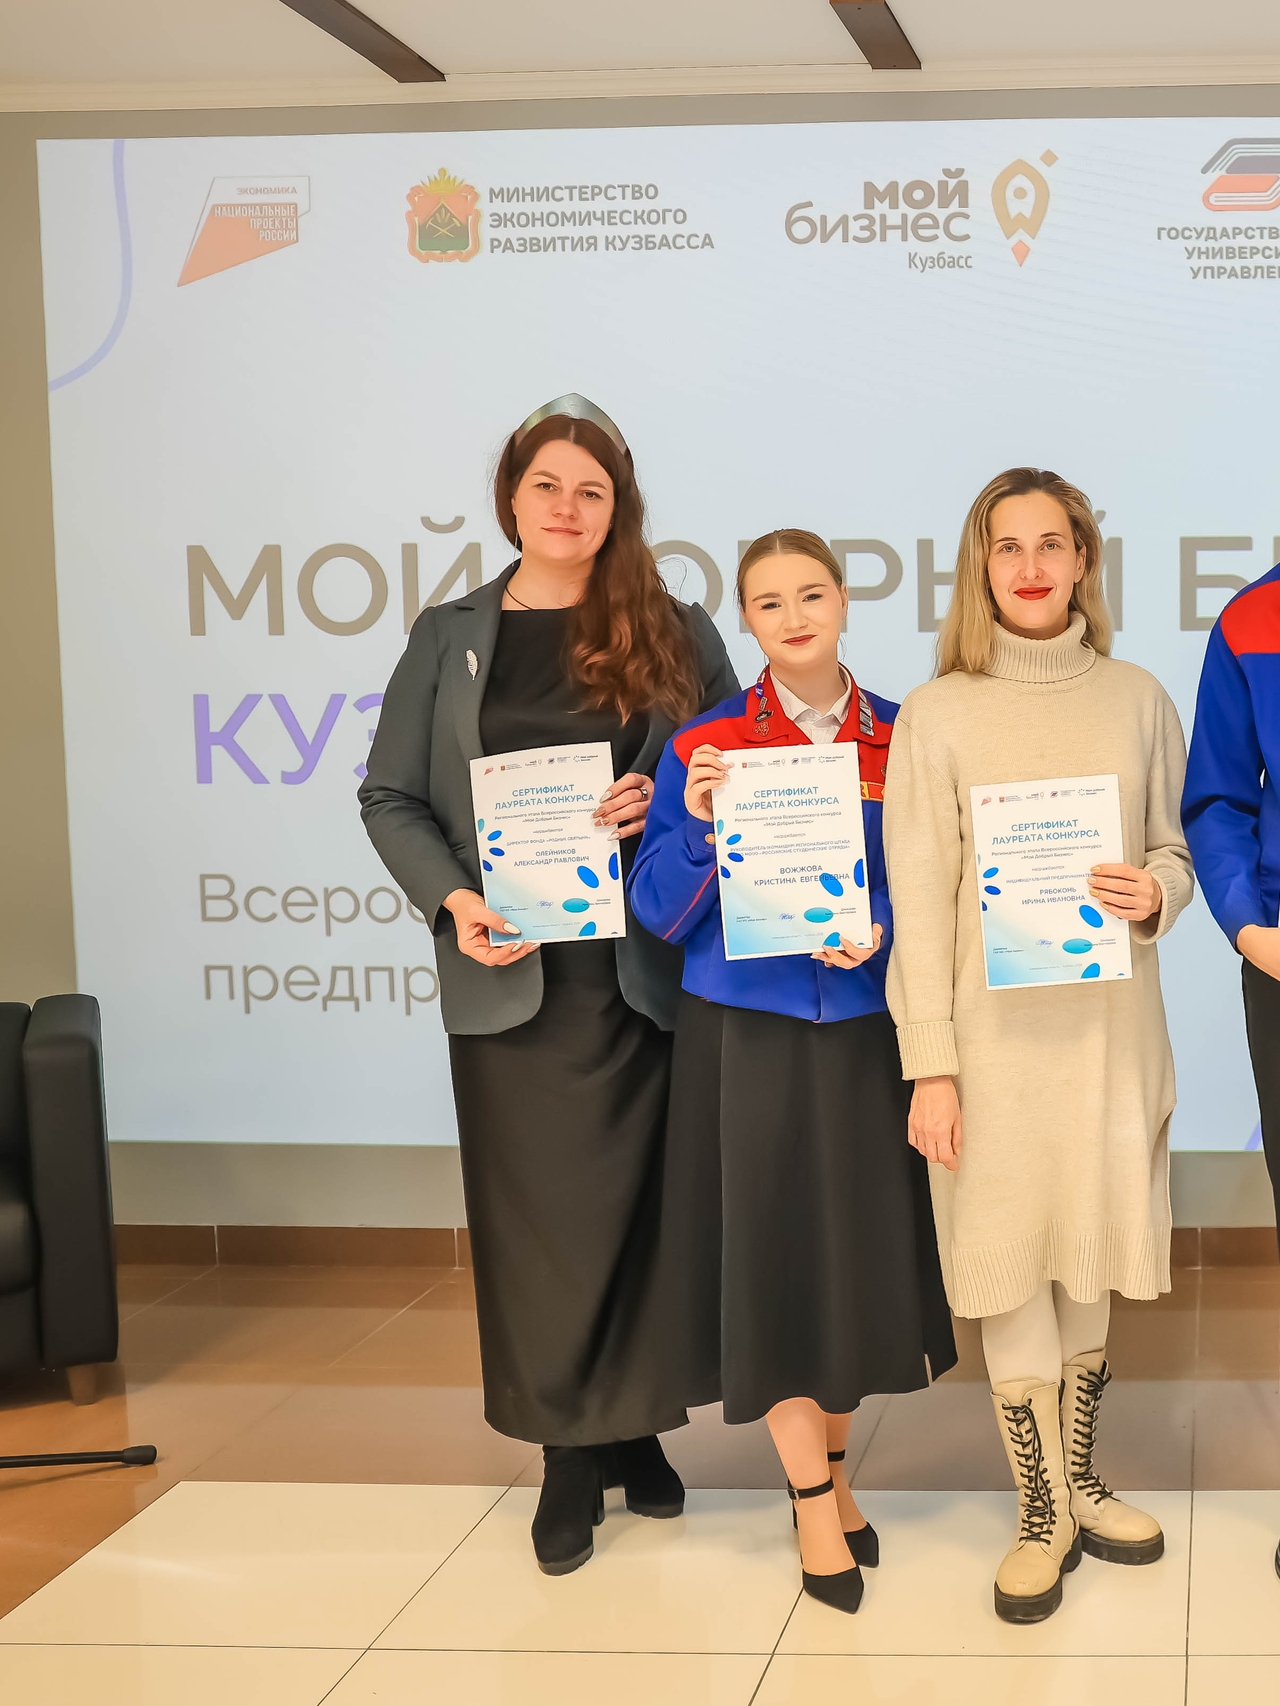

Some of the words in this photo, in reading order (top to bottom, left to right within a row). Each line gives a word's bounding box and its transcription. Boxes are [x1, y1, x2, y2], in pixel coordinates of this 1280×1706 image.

[237, 187, 298, 195] ЭКОНОМИКА
[488, 183, 659, 203] МИНИСТЕРСТВО
[863, 168, 969, 210] мой
[214, 205, 296, 218] НАЦИОНАЛЬНЫЕ
[489, 208, 688, 228] ЭКОНОМИЧЕСКОГО
[250, 218, 297, 229] ПРОЕКТЫ
[784, 201, 971, 245] бизнес
[259, 229, 297, 241] РОССИИ
[489, 236, 598, 254] РАЗВИТИЯ
[605, 233, 715, 252] КУЗБАССА
[908, 251, 973, 274] Кузбасс
[512, 784, 575, 797] СЕРТИФИКАТ
[754, 786, 819, 798] СЕРТИФИКАТ
[494, 798, 543, 810] ЛАУРЕАТА
[545, 793, 594, 804] КОНКУРСА
[735, 800, 785, 811] ЛАУРЕАТА
[787, 796, 839, 807] КОНКУРСА
[1011, 819, 1079, 832] СЕРТИФИКАТ
[992, 833, 1043, 845] ЛАУРЕАТА
[1046, 829, 1100, 840] КОНКУРСА
[535, 848, 576, 857] ОЛЕЙНИКОВ
[514, 858, 553, 867] АЛЕКСАНДР
[554, 855, 590, 864] ПАВЛОВИЧ
[780, 865, 823, 874] ВОЖЖОВА
[754, 877, 797, 886] КРИСТИНА
[1040, 887, 1076, 895] РЯБОКОНЬ
[1047, 895, 1086, 903] ИВАНОВНА
